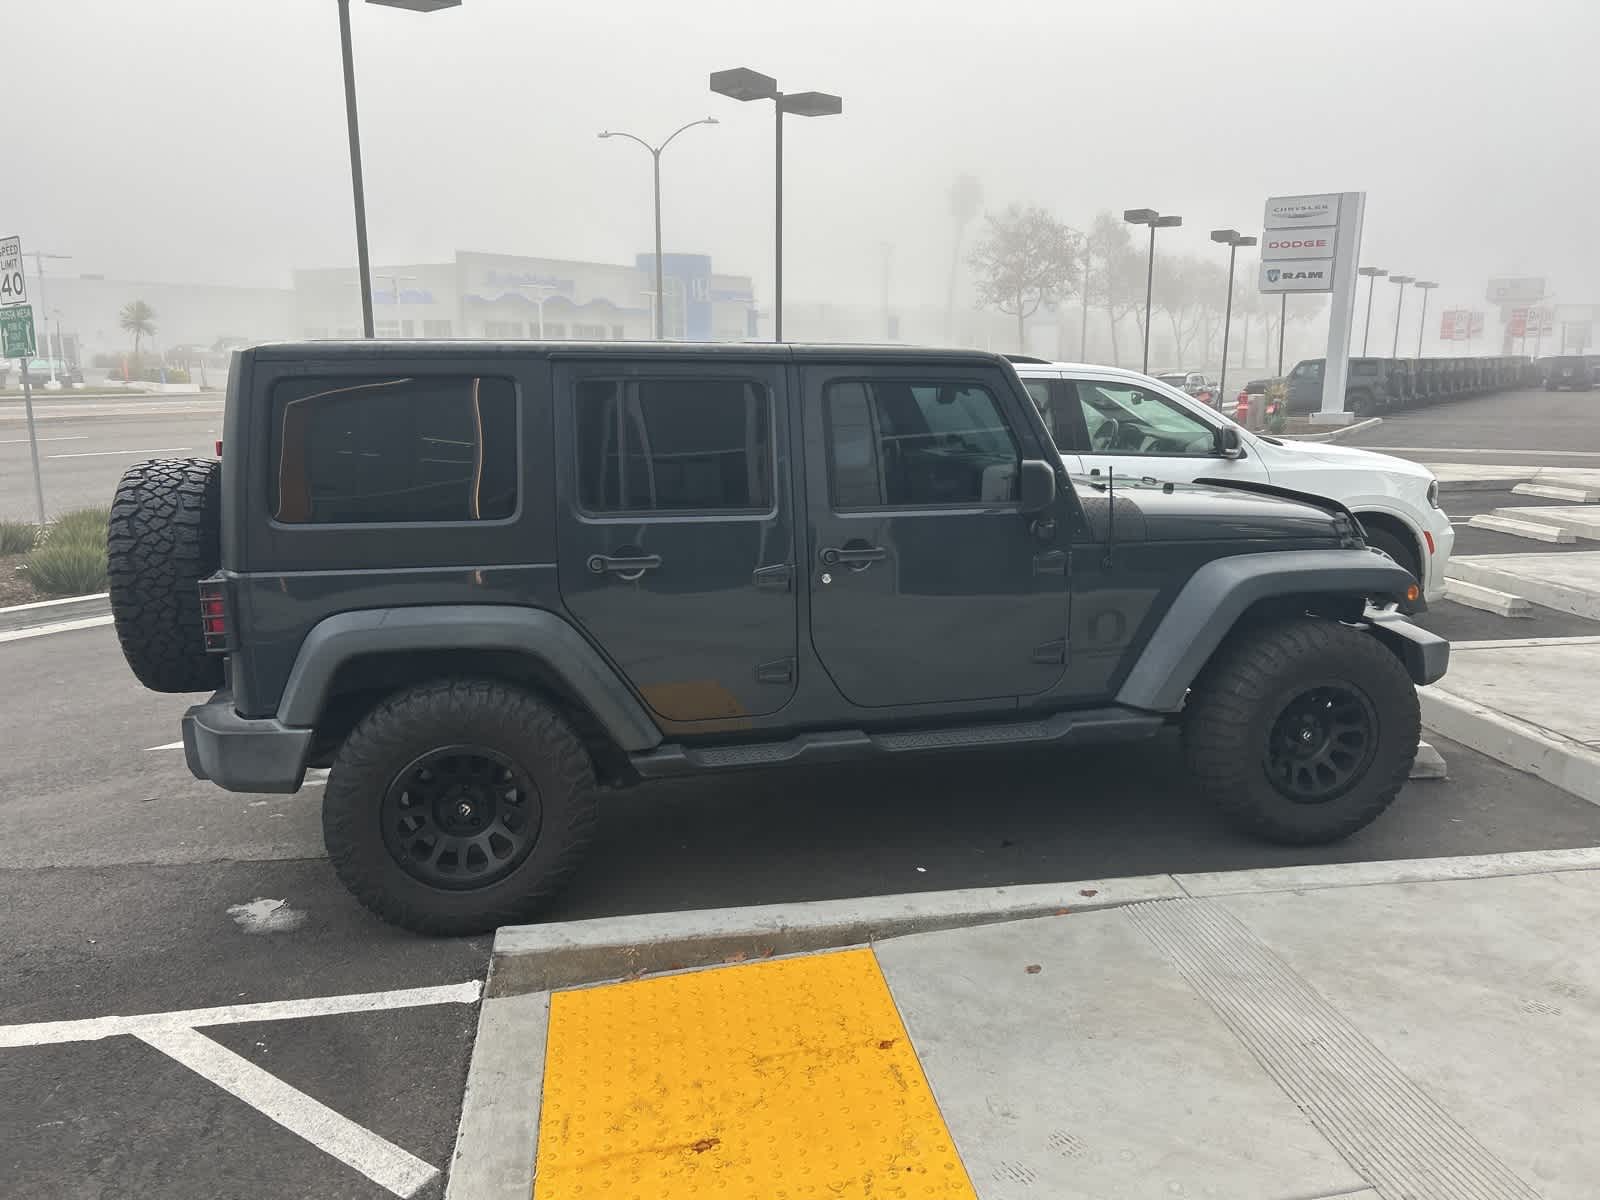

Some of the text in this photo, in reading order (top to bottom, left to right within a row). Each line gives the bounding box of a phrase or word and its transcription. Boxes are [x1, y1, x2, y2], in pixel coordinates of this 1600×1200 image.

[1273, 204, 1328, 212] CHRYSLER
[1269, 240, 1326, 248] DODGE
[1, 258, 17, 270] LIMIT
[2, 271, 23, 296] 40
